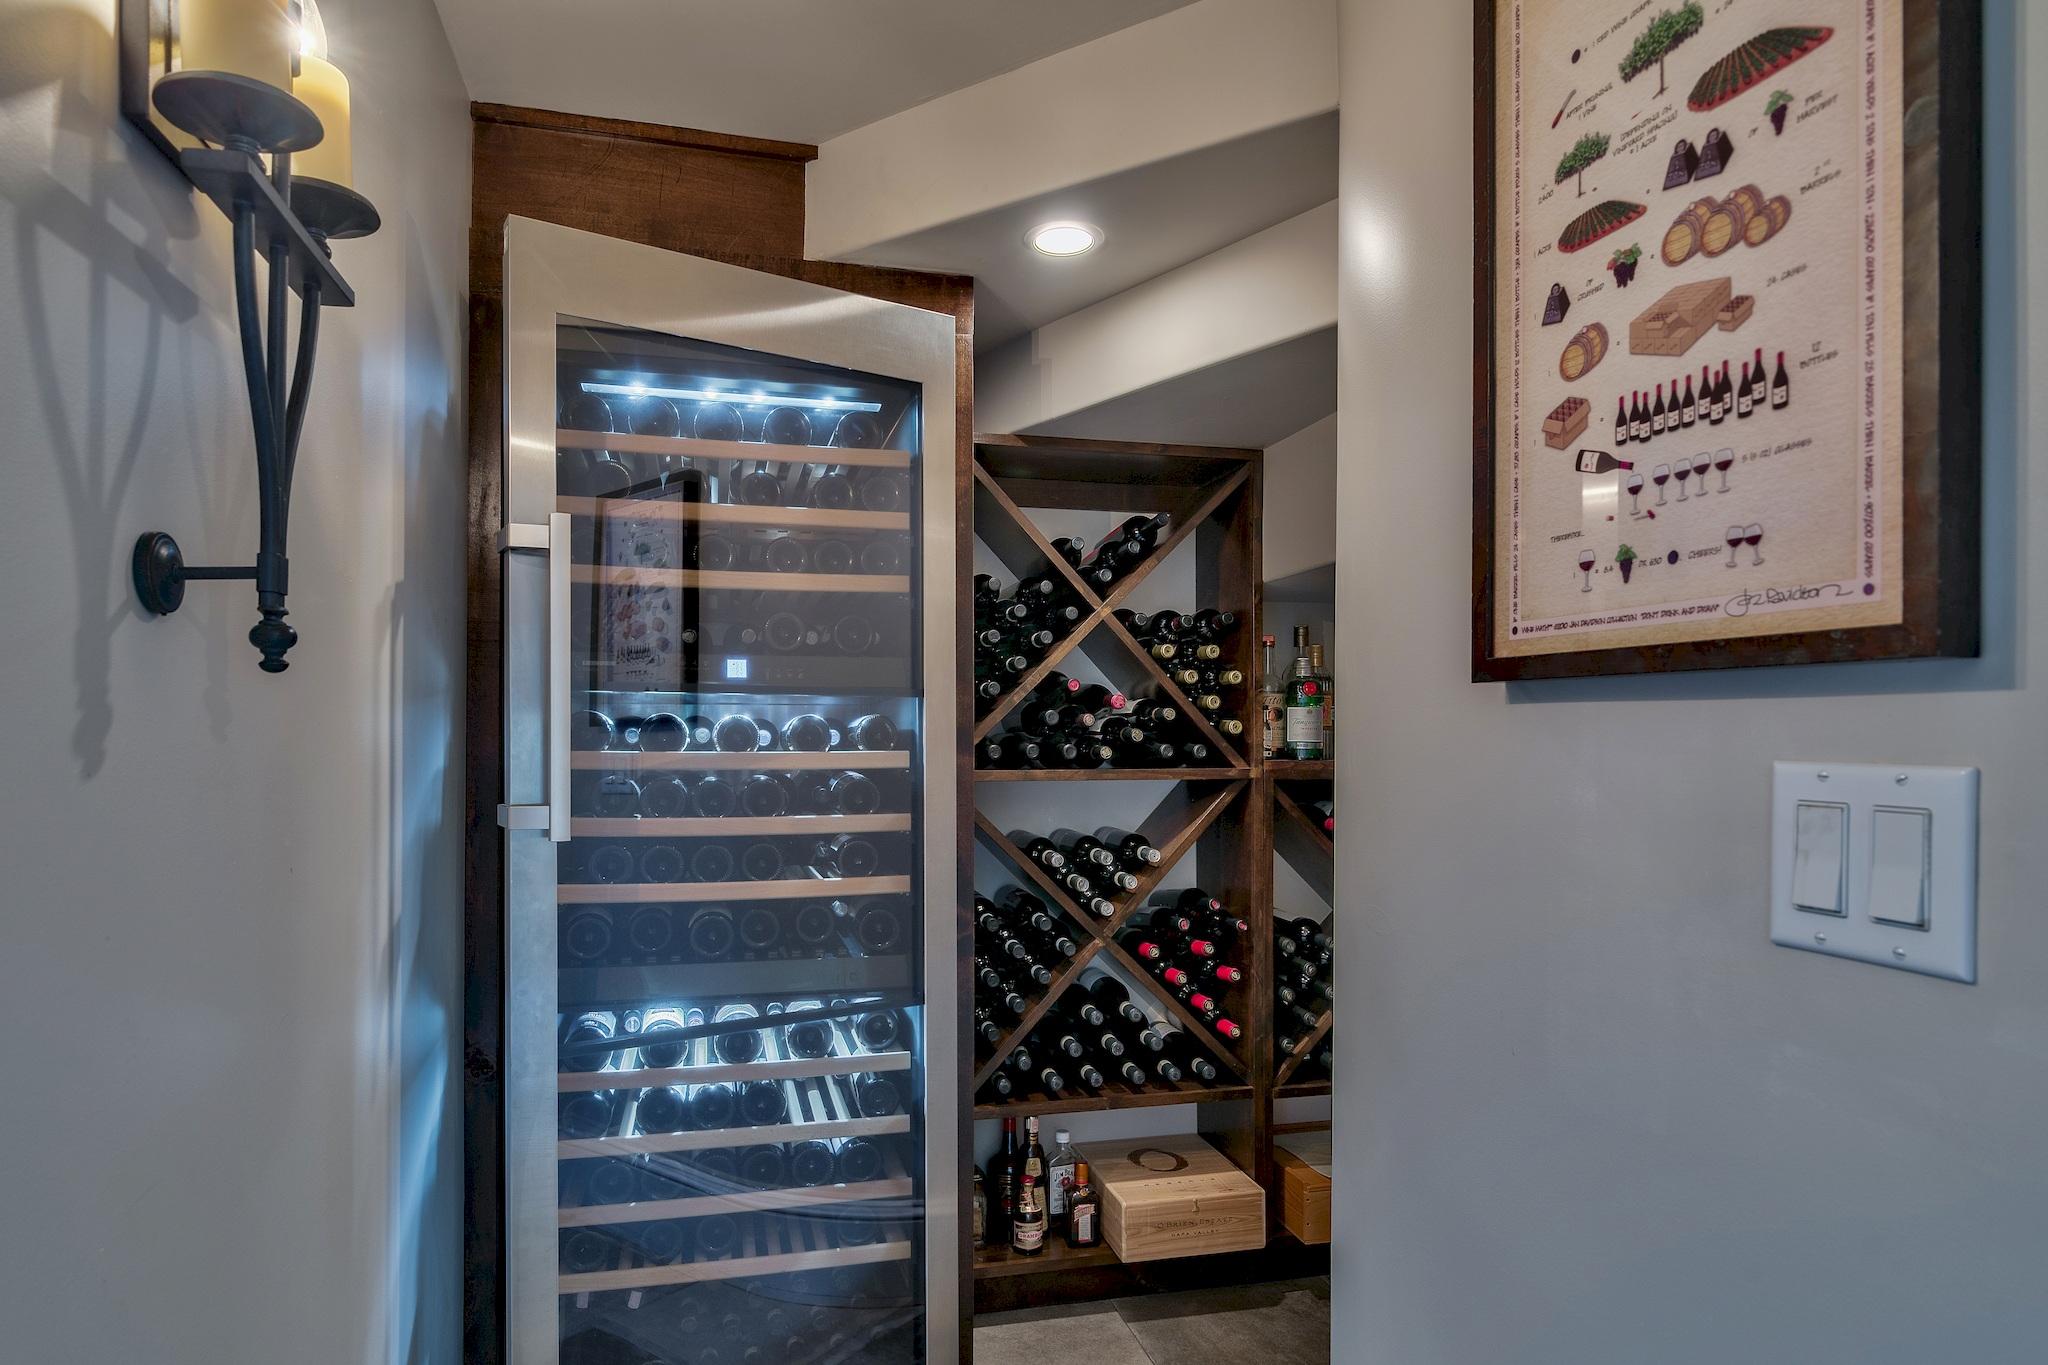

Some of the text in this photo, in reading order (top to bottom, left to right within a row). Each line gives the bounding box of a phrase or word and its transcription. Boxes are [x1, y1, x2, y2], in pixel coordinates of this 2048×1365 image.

[1796, 94, 1838, 124] HARVEST
[1865, 149, 1875, 178] THEN
[1800, 169, 1842, 195] BARRELS
[1865, 184, 1875, 204] TON
[1865, 312, 1875, 332] TON
[1800, 350, 1838, 369] BOTTLES
[1865, 375, 1874, 416] BARRELS
[1865, 420, 1874, 448] THEN
[1864, 456, 1874, 492] BARREL
[1681, 606, 1695, 615] AND
